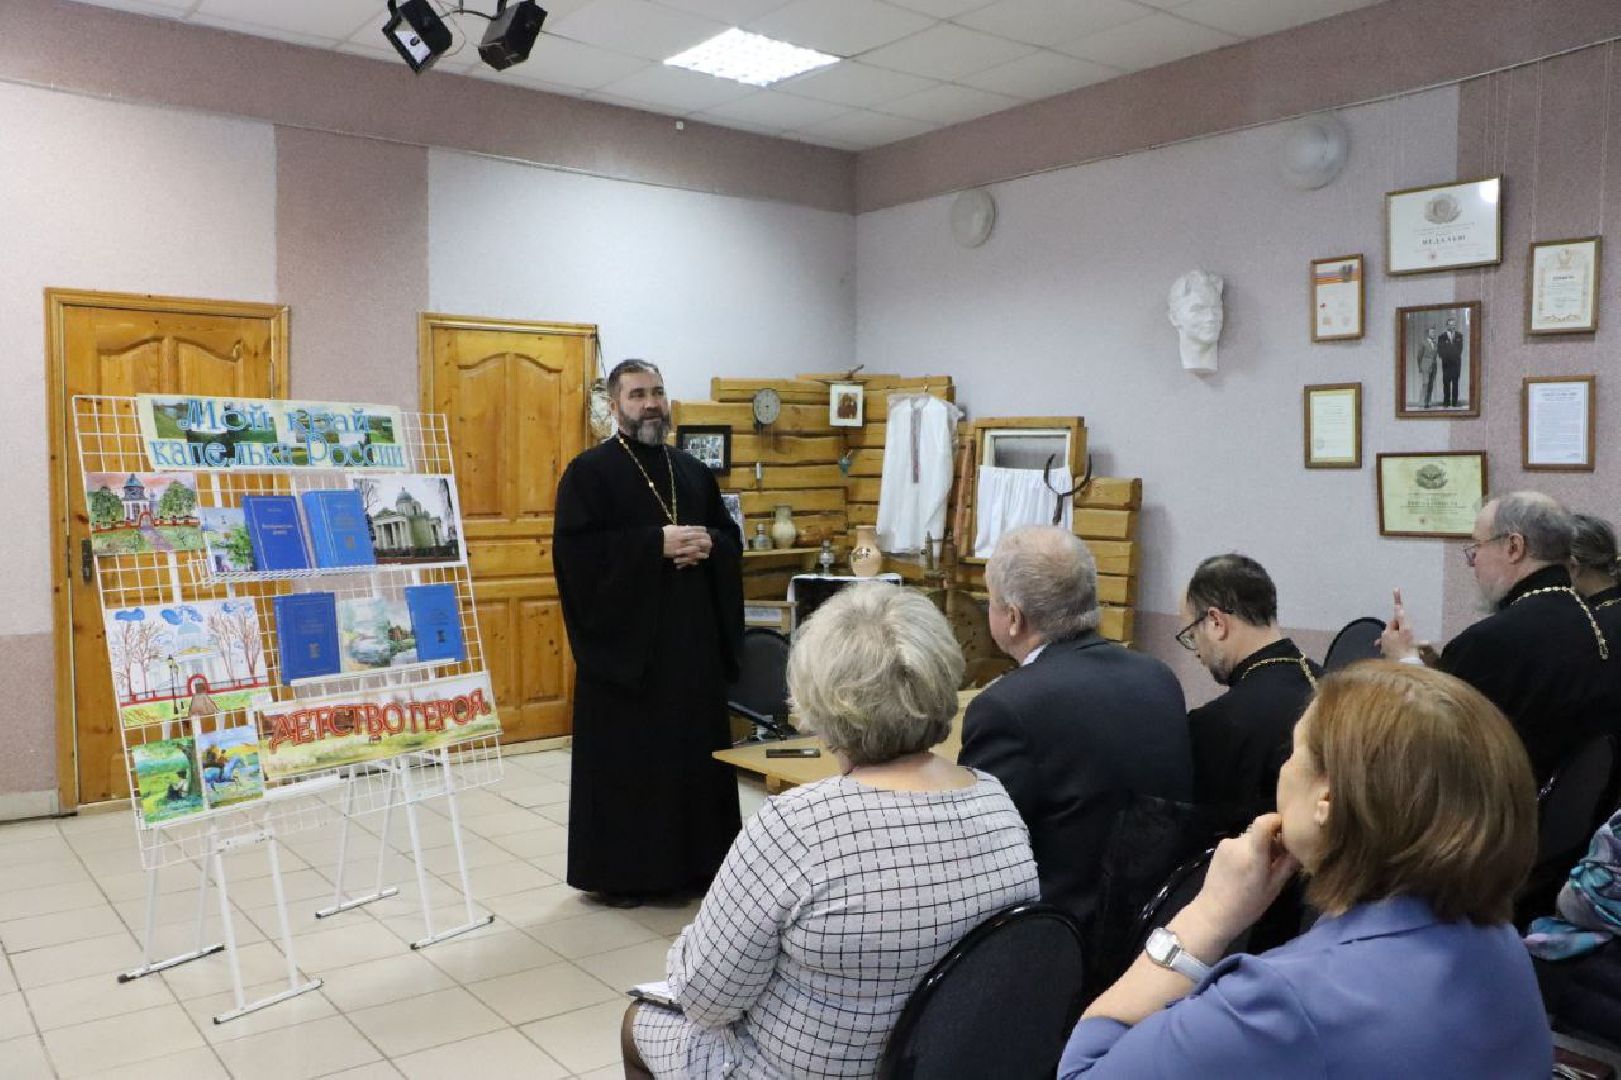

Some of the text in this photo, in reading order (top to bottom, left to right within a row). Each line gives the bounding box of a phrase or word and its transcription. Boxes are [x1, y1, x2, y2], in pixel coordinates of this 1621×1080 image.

[177, 399, 272, 432] Мой
[286, 407, 370, 437] край
[149, 432, 404, 467] капелька России
[269, 687, 492, 753] ДЕТСТВО ГЕРОЯ
